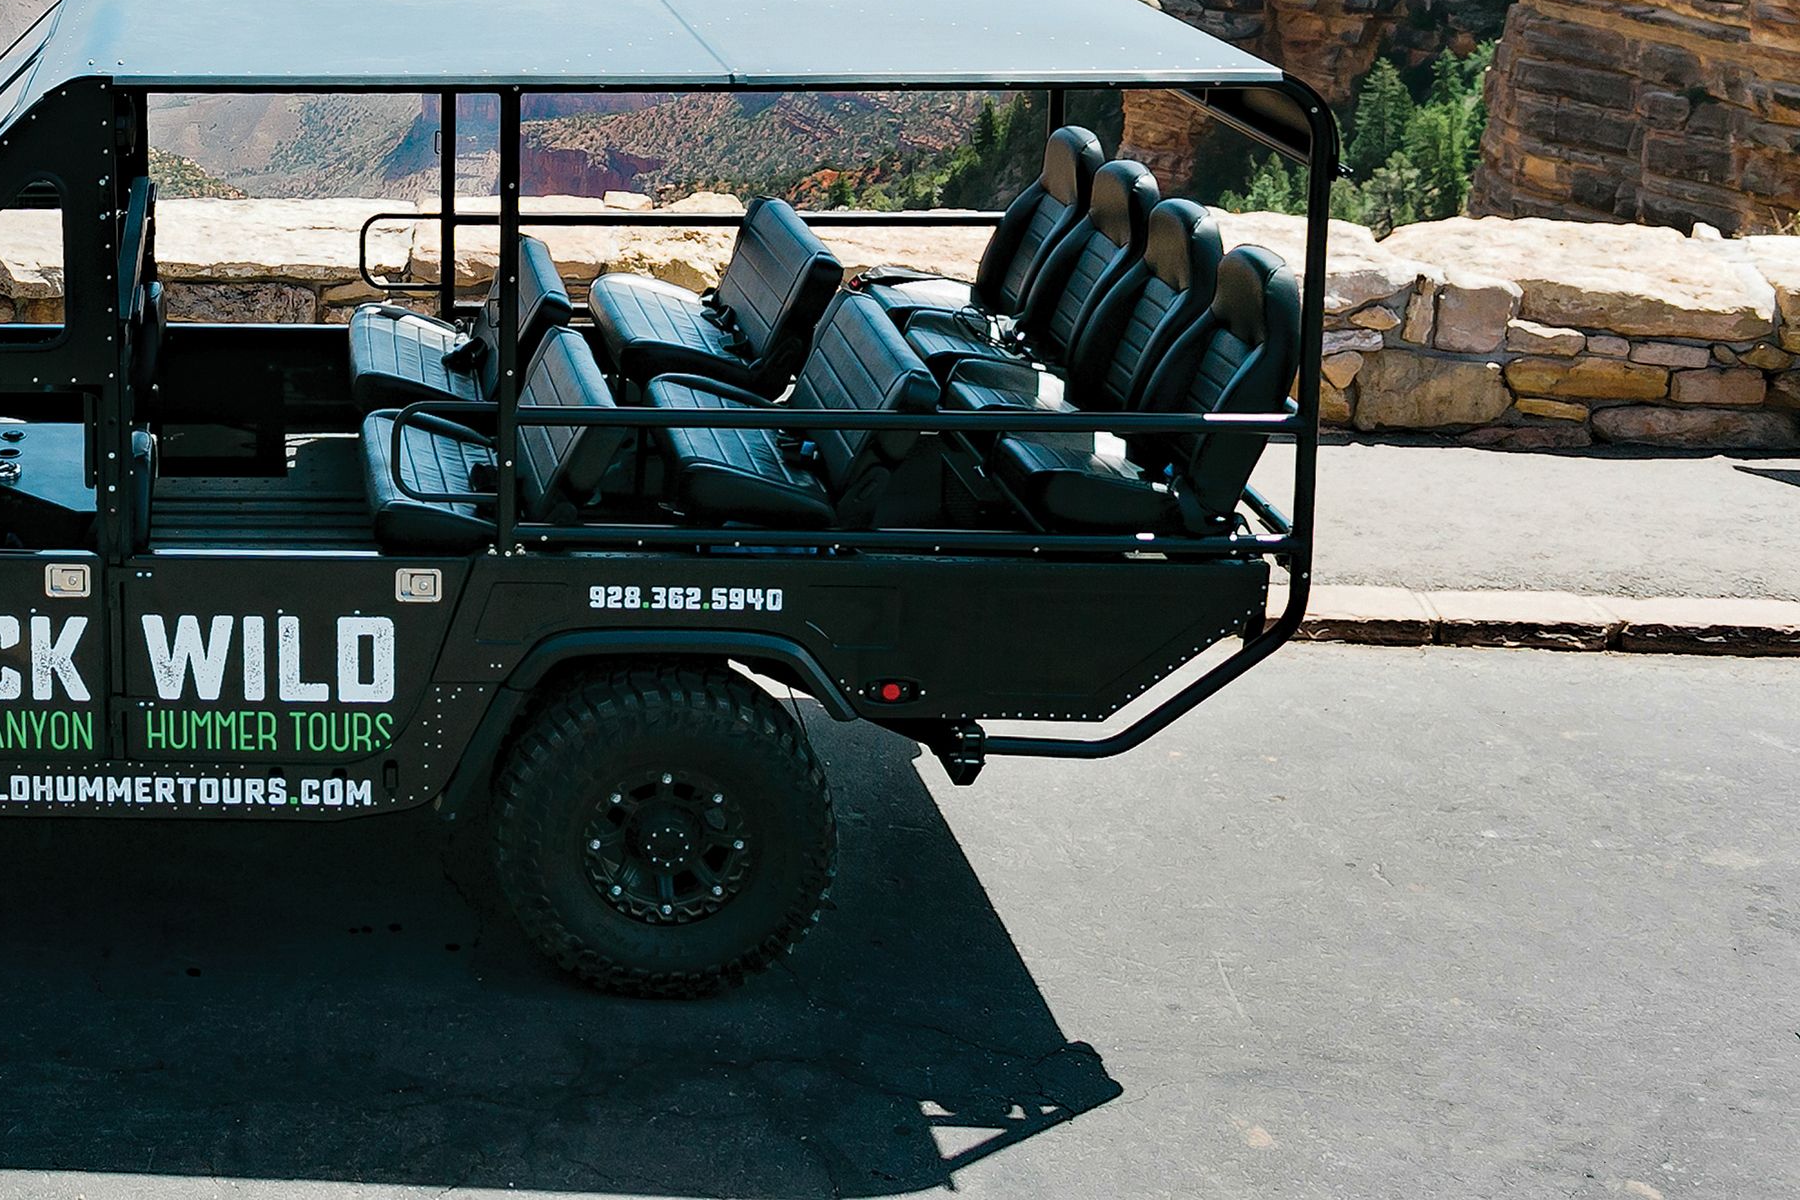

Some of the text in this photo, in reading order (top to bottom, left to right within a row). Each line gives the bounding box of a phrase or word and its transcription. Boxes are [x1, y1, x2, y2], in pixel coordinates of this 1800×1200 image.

[589, 586, 783, 611] 928.362.5940
[140, 614, 395, 703] WILD
[146, 710, 277, 751] HUMMER
[288, 711, 394, 752] TOURS
